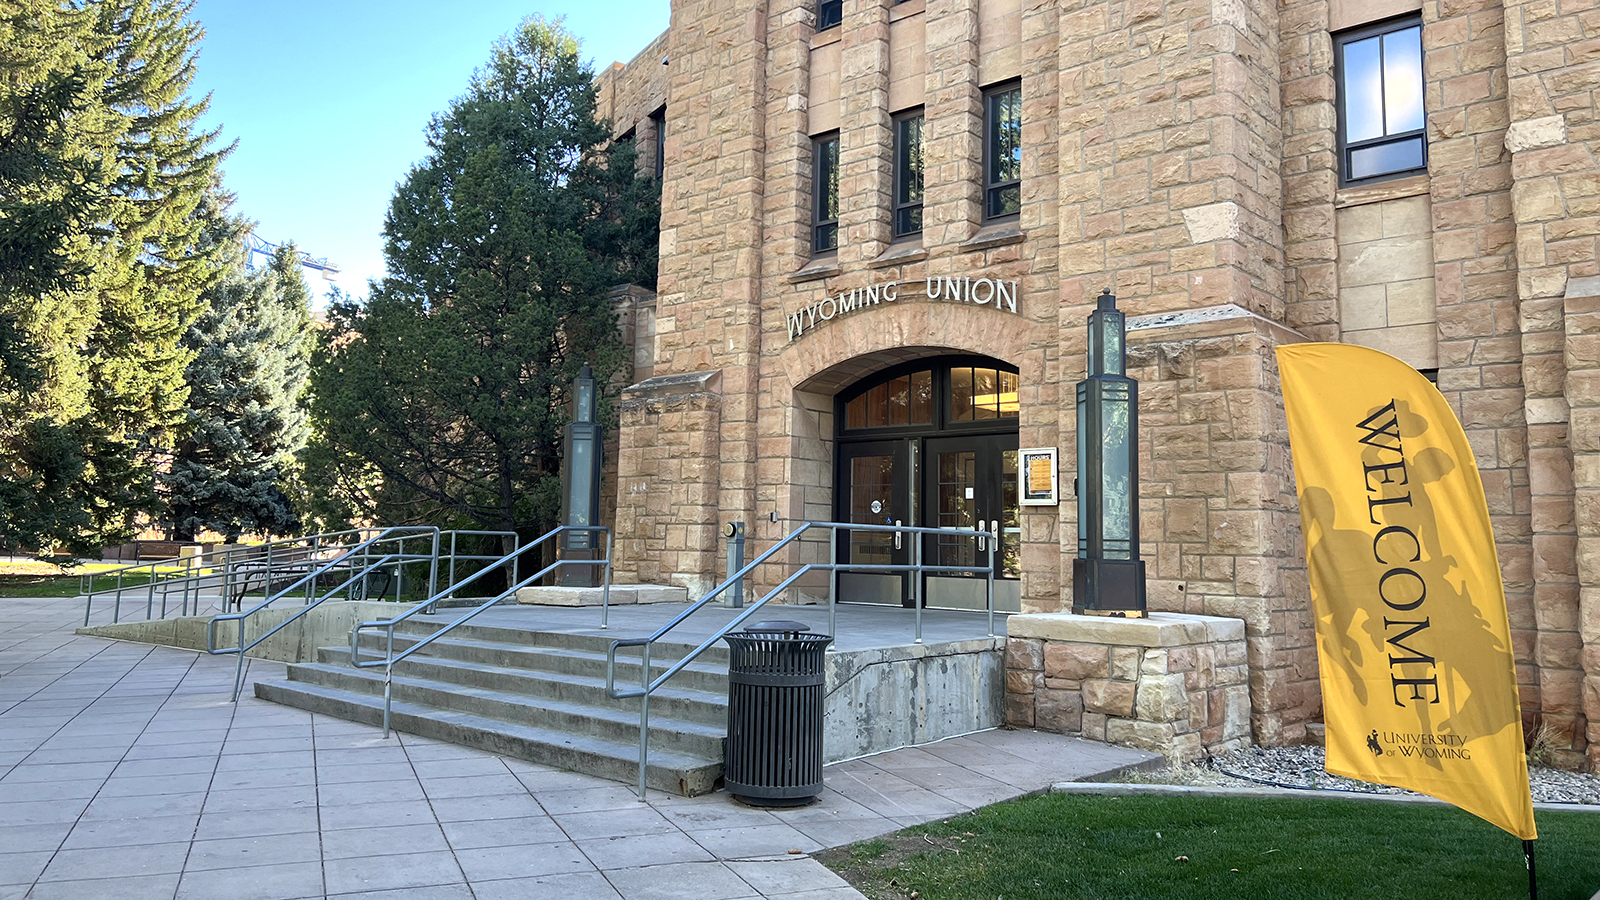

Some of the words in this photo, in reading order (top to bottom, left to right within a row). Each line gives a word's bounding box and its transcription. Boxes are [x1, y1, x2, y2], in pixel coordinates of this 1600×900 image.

[786, 281, 898, 342] WYOMING
[926, 276, 1018, 314] UNION
[1355, 397, 1441, 708] WELCOME
[1383, 731, 1468, 747] UNIVERSITY
[1385, 749, 1396, 757] OF
[1398, 745, 1471, 760] WYOMING
